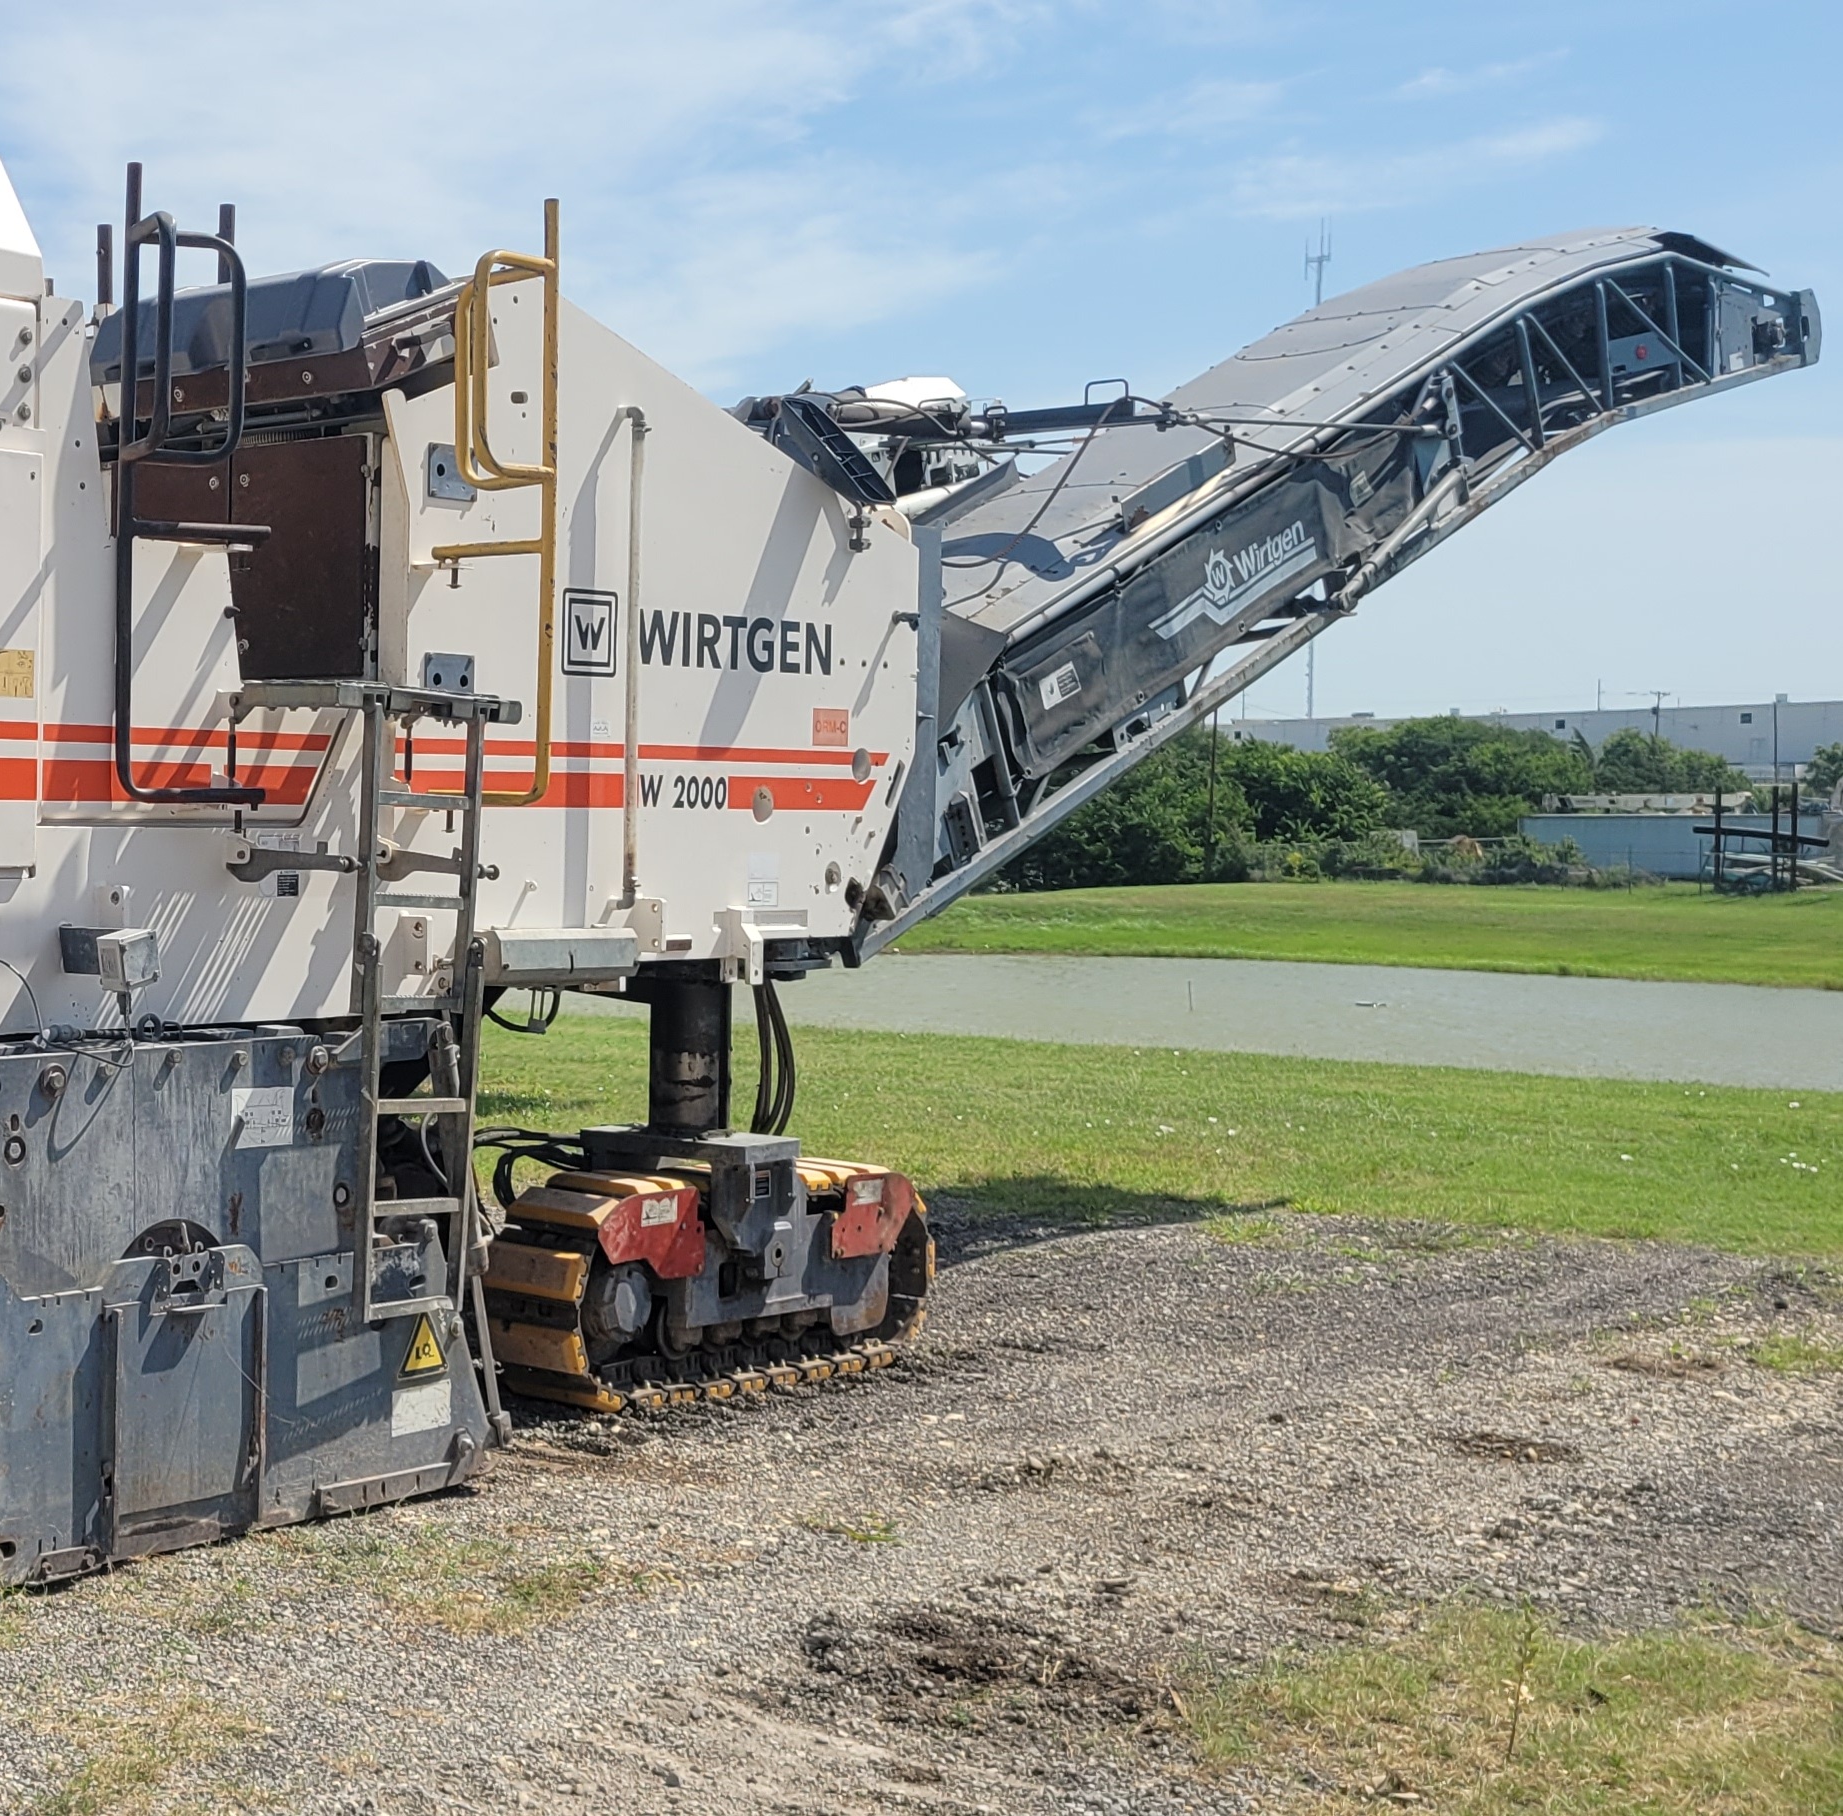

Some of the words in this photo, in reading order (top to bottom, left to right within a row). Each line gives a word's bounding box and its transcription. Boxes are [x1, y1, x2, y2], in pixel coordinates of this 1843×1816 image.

[1232, 520, 1305, 581] Wirtgen
[574, 614, 605, 651] W
[639, 608, 832, 676] WIRTGEN
[640, 774, 663, 808] W
[672, 775, 727, 810] 2000
